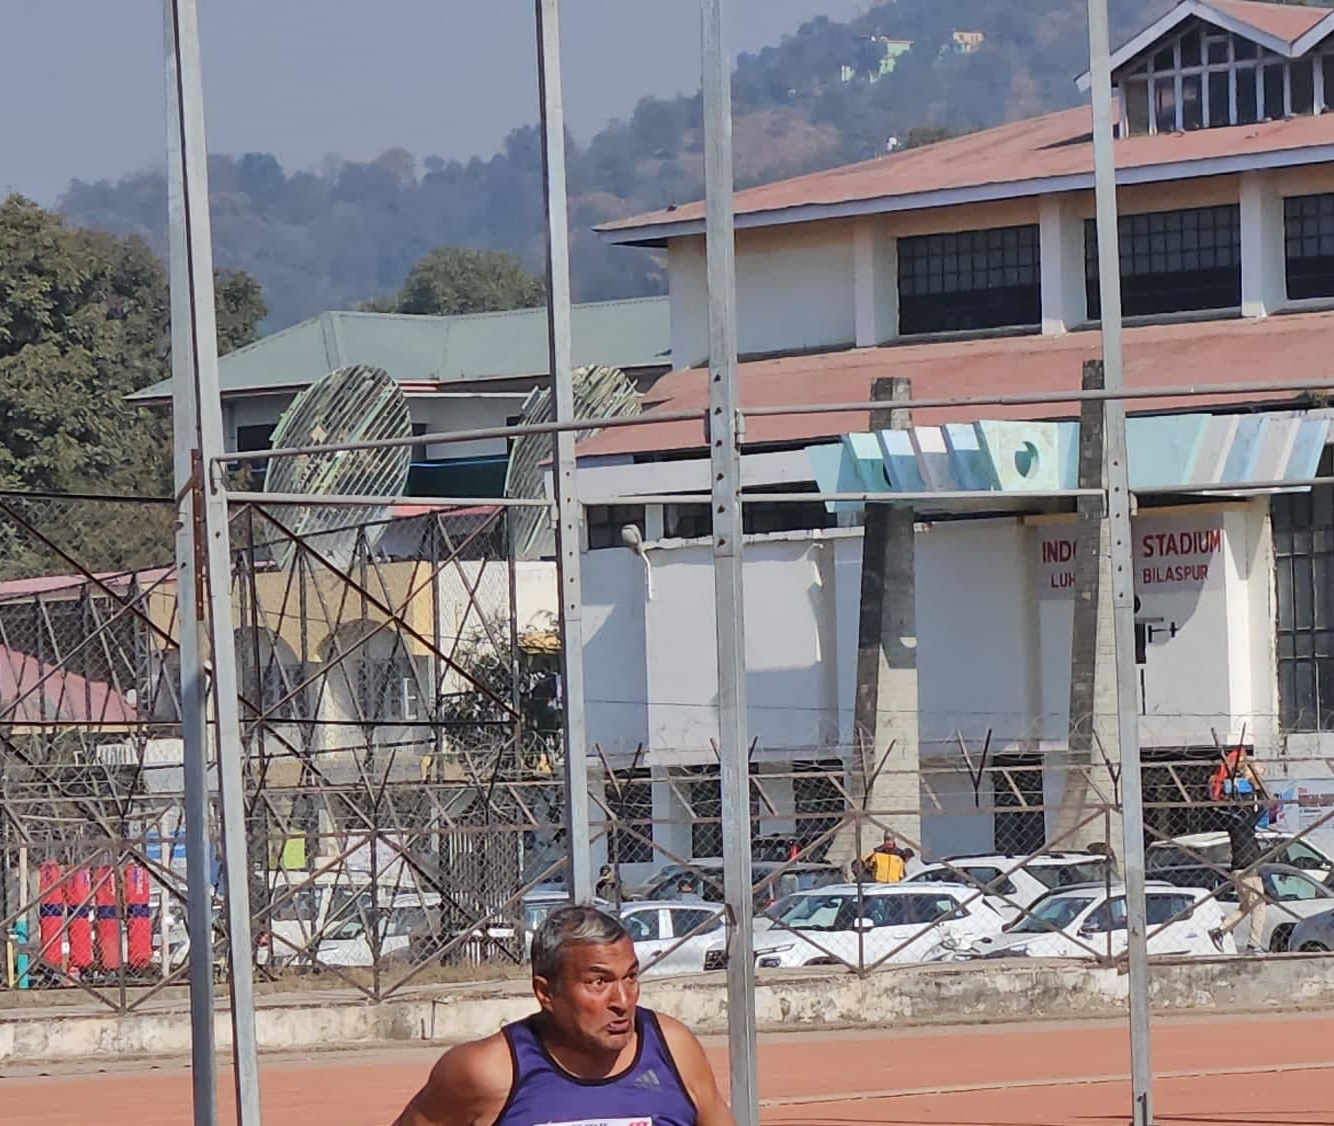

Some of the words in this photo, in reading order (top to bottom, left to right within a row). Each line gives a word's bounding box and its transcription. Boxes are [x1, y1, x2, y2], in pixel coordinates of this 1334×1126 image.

[1042, 540, 1077, 563] IND
[1142, 529, 1221, 558] STADIUM
[1143, 564, 1208, 584] BILASPUR
